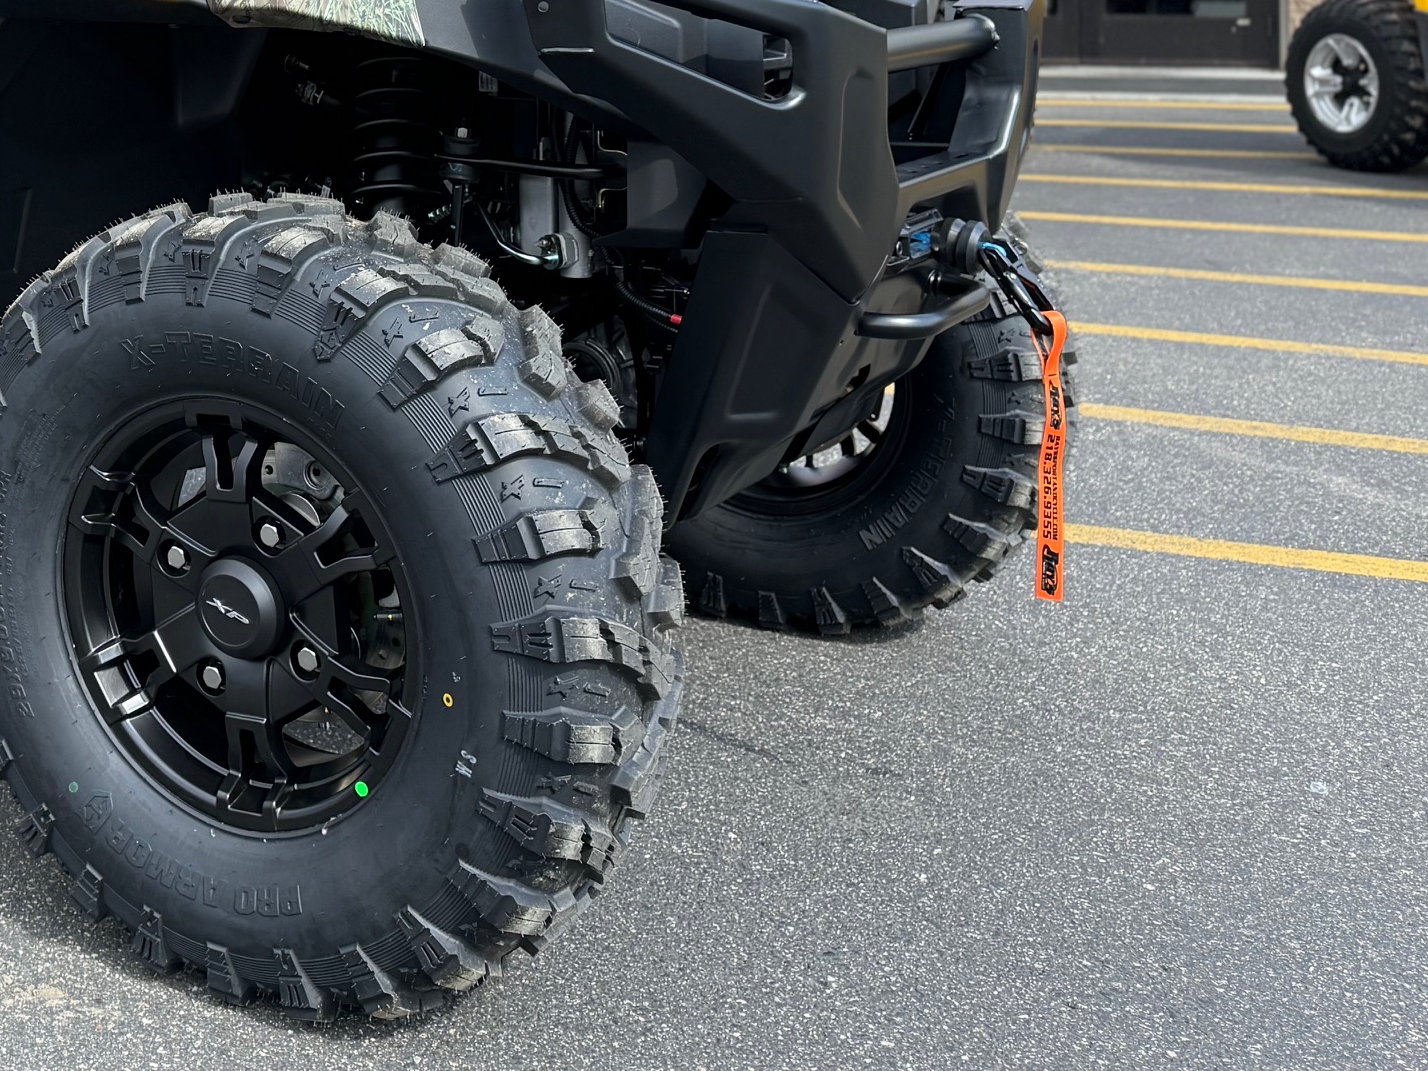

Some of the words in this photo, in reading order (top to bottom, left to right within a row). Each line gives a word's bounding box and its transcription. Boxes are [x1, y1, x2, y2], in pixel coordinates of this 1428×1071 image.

[119, 331, 345, 429] X-TERRAIN
[1043, 434, 1056, 540] 218.326.9355
[205, 597, 250, 625] XP
[105, 818, 219, 908] ARMOR
[233, 883, 302, 917] PRO
